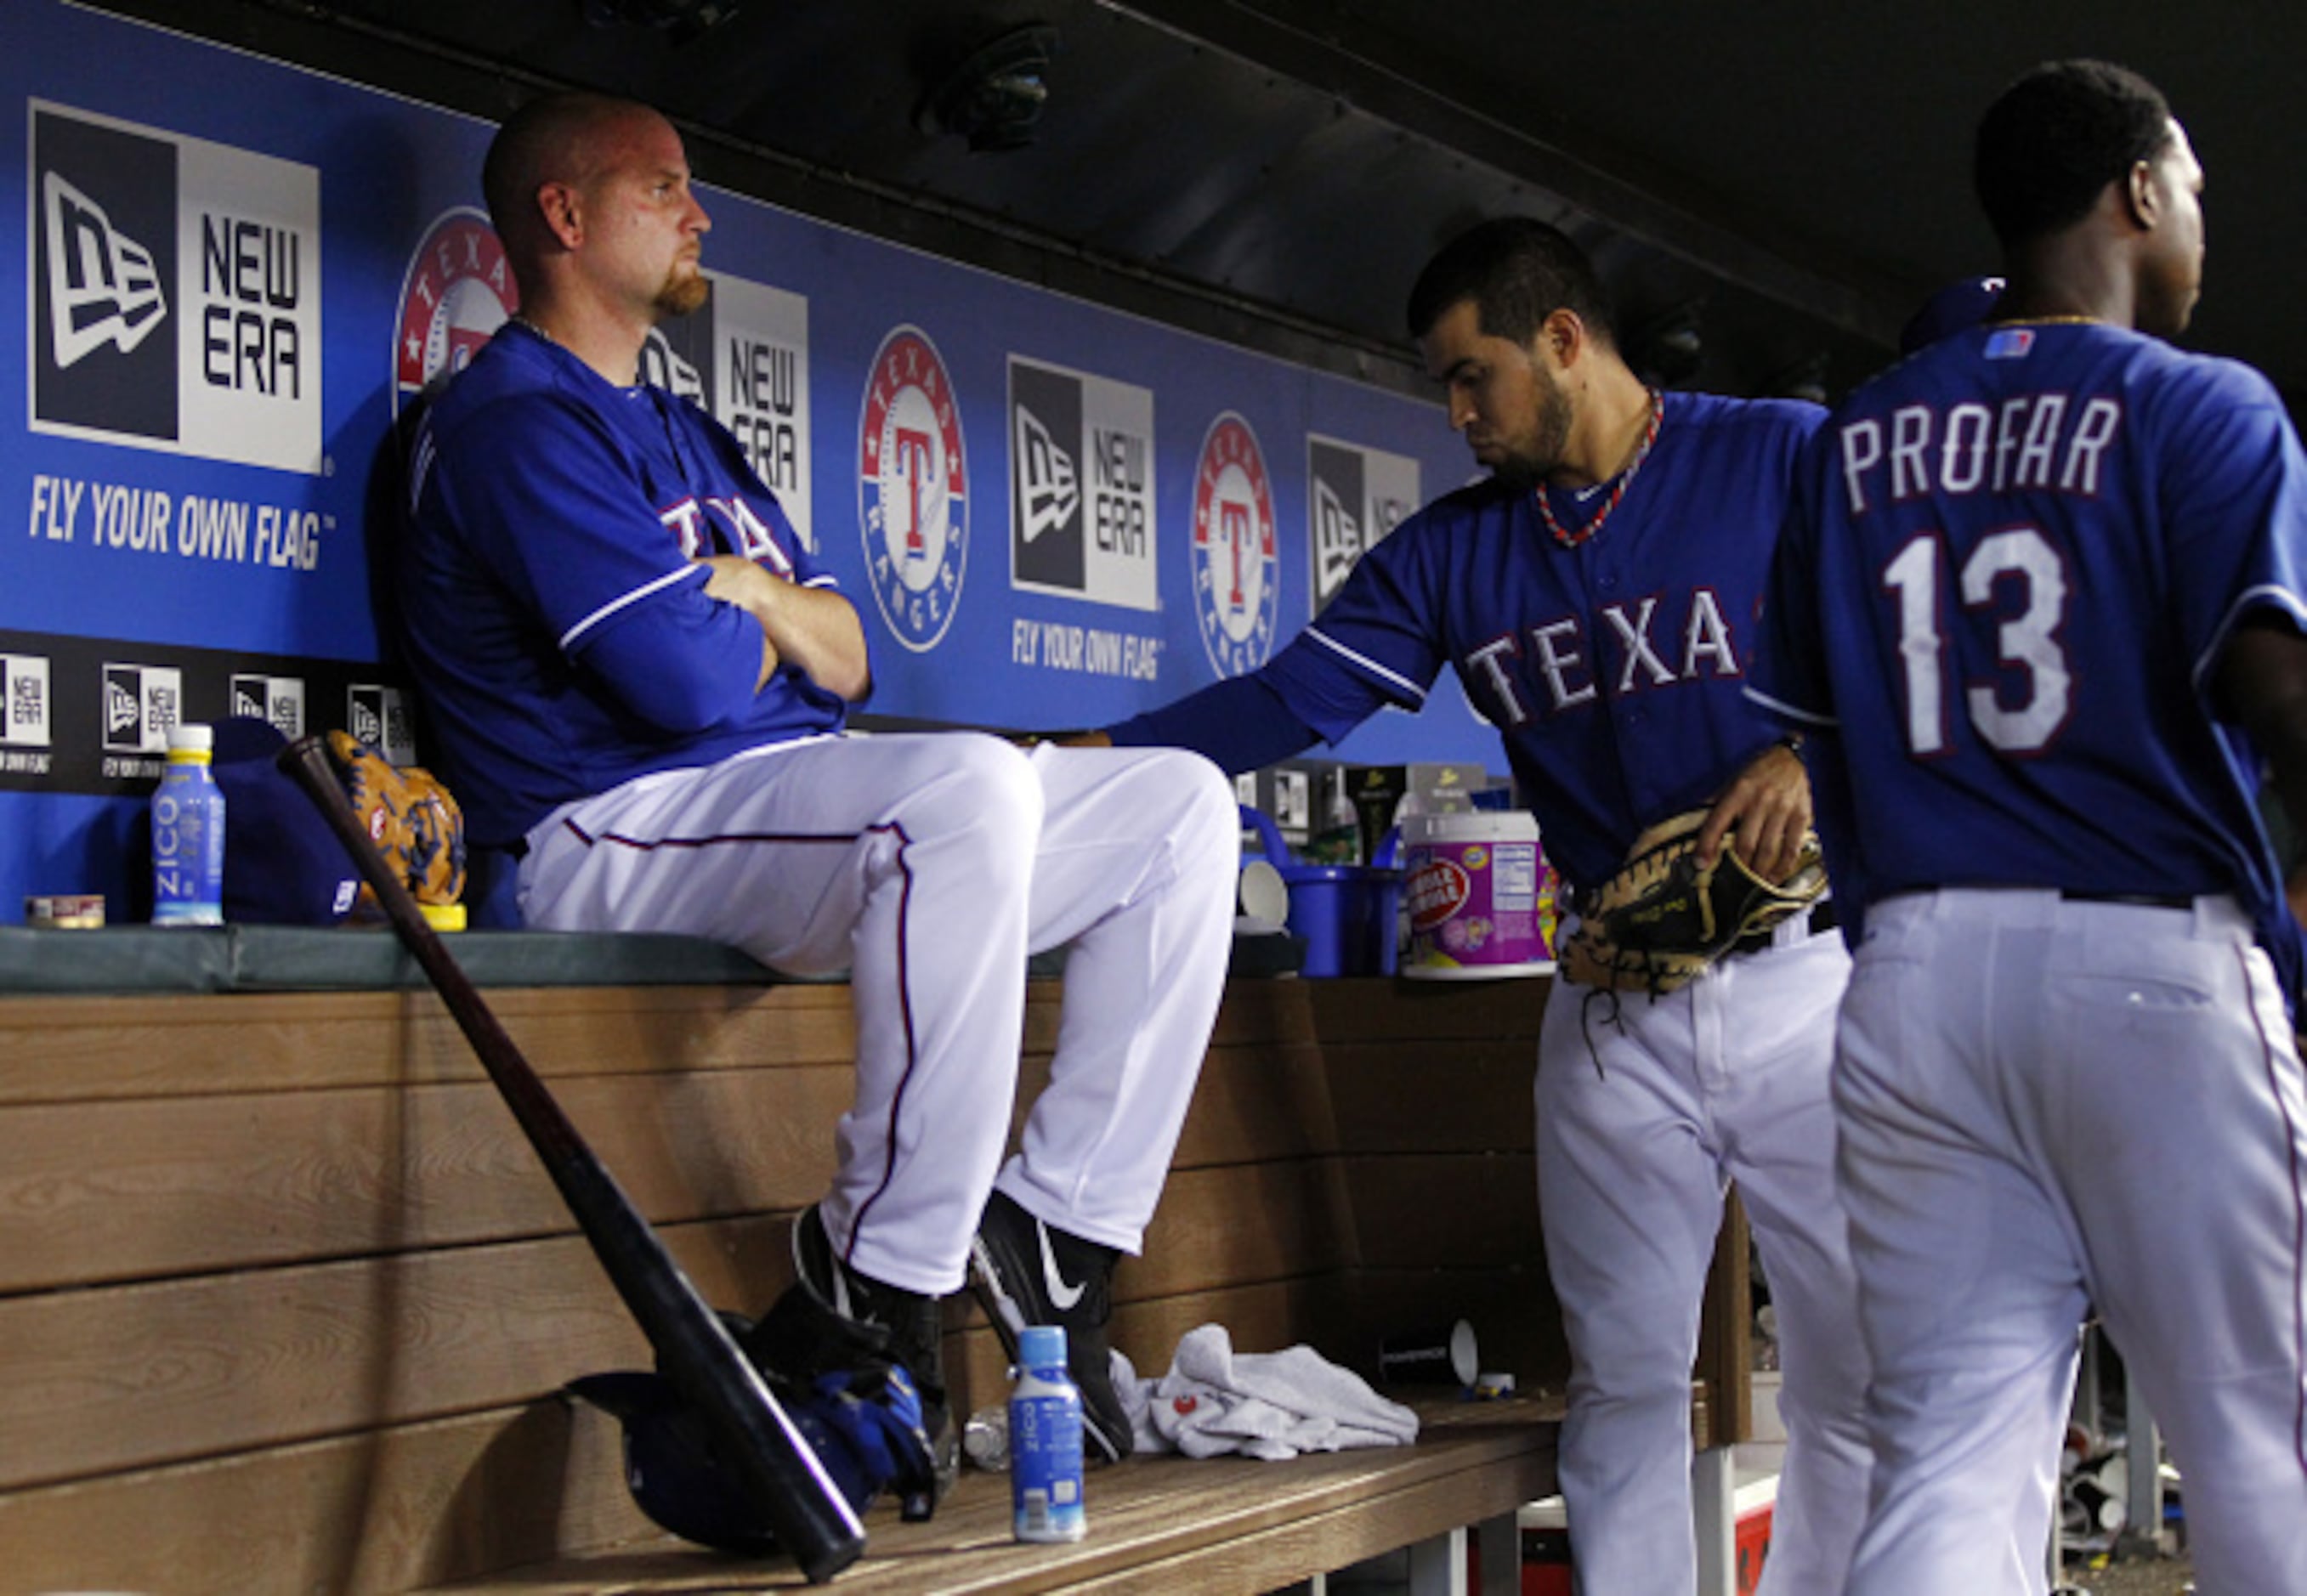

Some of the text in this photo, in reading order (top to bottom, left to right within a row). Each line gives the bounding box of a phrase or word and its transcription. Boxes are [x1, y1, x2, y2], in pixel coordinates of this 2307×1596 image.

[202, 212, 299, 311] NEW
[416, 232, 508, 308] TEXA
[203, 303, 300, 400] ERA
[731, 337, 794, 416] NEW
[874, 347, 952, 428] TEXAS
[1094, 429, 1145, 493] NEW
[1841, 395, 2120, 513] PROFAR
[29, 473, 321, 570] FLY YOUR OWN FLAG
[1097, 493, 1146, 557] ERA
[1012, 619, 1157, 681] FLY YOUR OWN FLAG
[1465, 590, 1741, 724] TEXA
[1884, 527, 2072, 753] 13
[155, 795, 180, 897] ZICO
